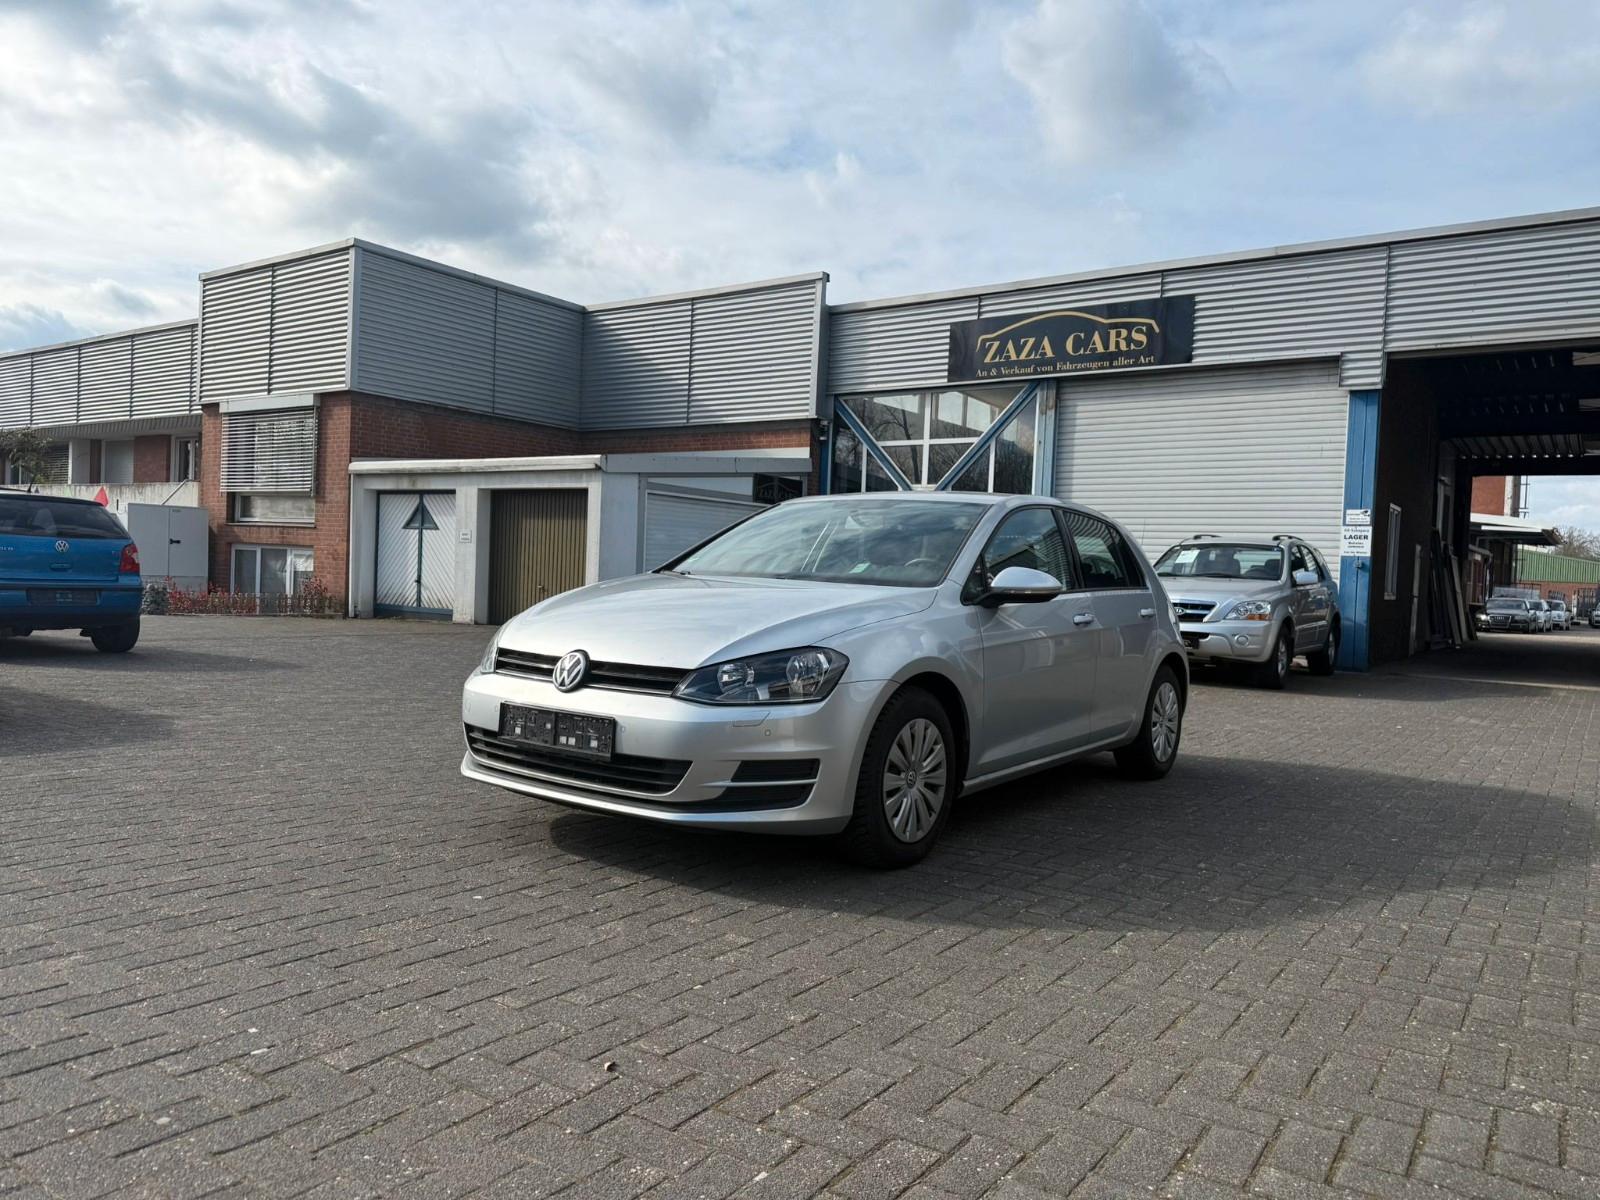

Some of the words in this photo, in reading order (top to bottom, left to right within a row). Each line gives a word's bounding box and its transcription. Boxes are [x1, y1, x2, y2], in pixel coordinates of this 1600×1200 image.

[984, 336, 1055, 363] ZAZA
[1065, 326, 1147, 356] CARS
[976, 369, 988, 377] An
[990, 368, 998, 376] &
[1001, 365, 1036, 375] Verkauf
[1056, 361, 1109, 371] Fahrzeugen
[1112, 357, 1136, 366] aller
[1138, 355, 1155, 364] Art
